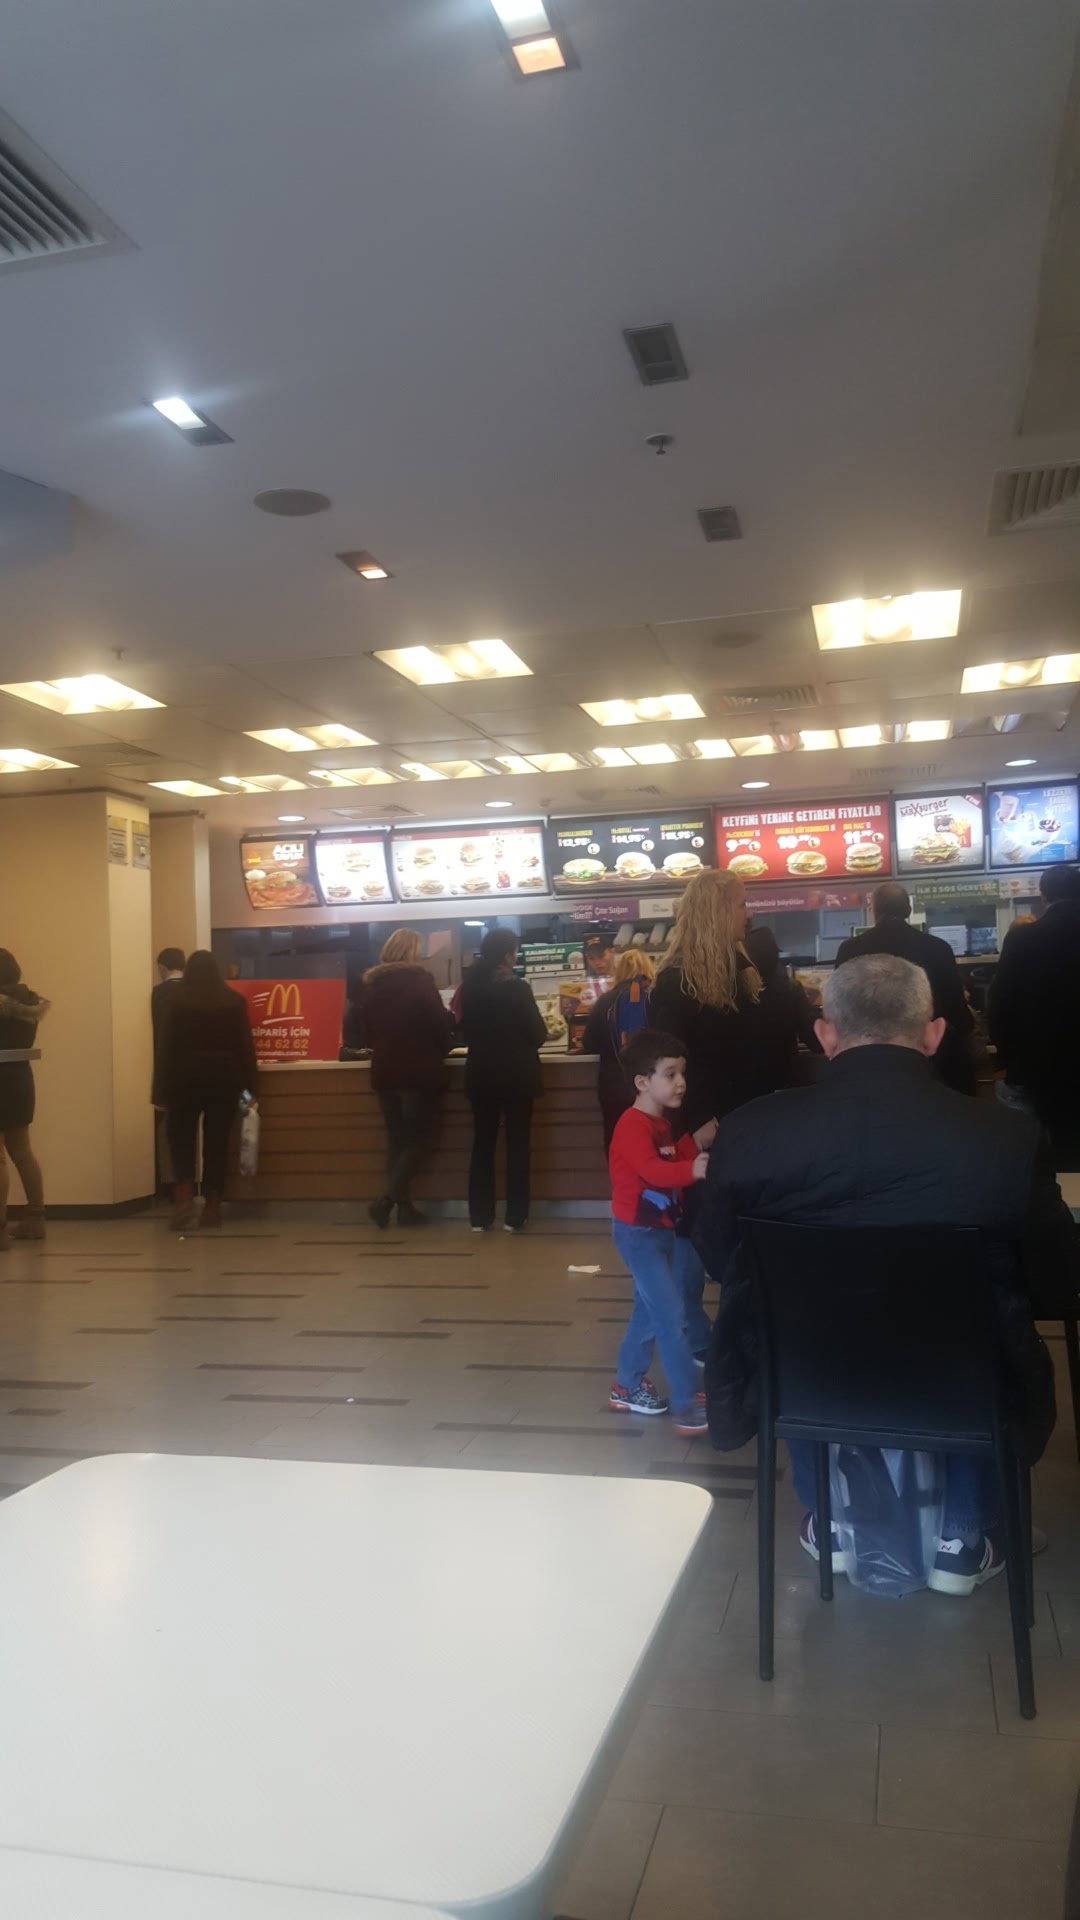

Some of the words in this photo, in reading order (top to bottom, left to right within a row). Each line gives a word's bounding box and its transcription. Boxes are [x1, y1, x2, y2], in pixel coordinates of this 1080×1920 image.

[290, 1026, 311, 1038] İÇİN
[275, 1039, 289, 1049] 62
[293, 1039, 309, 1049] 62
